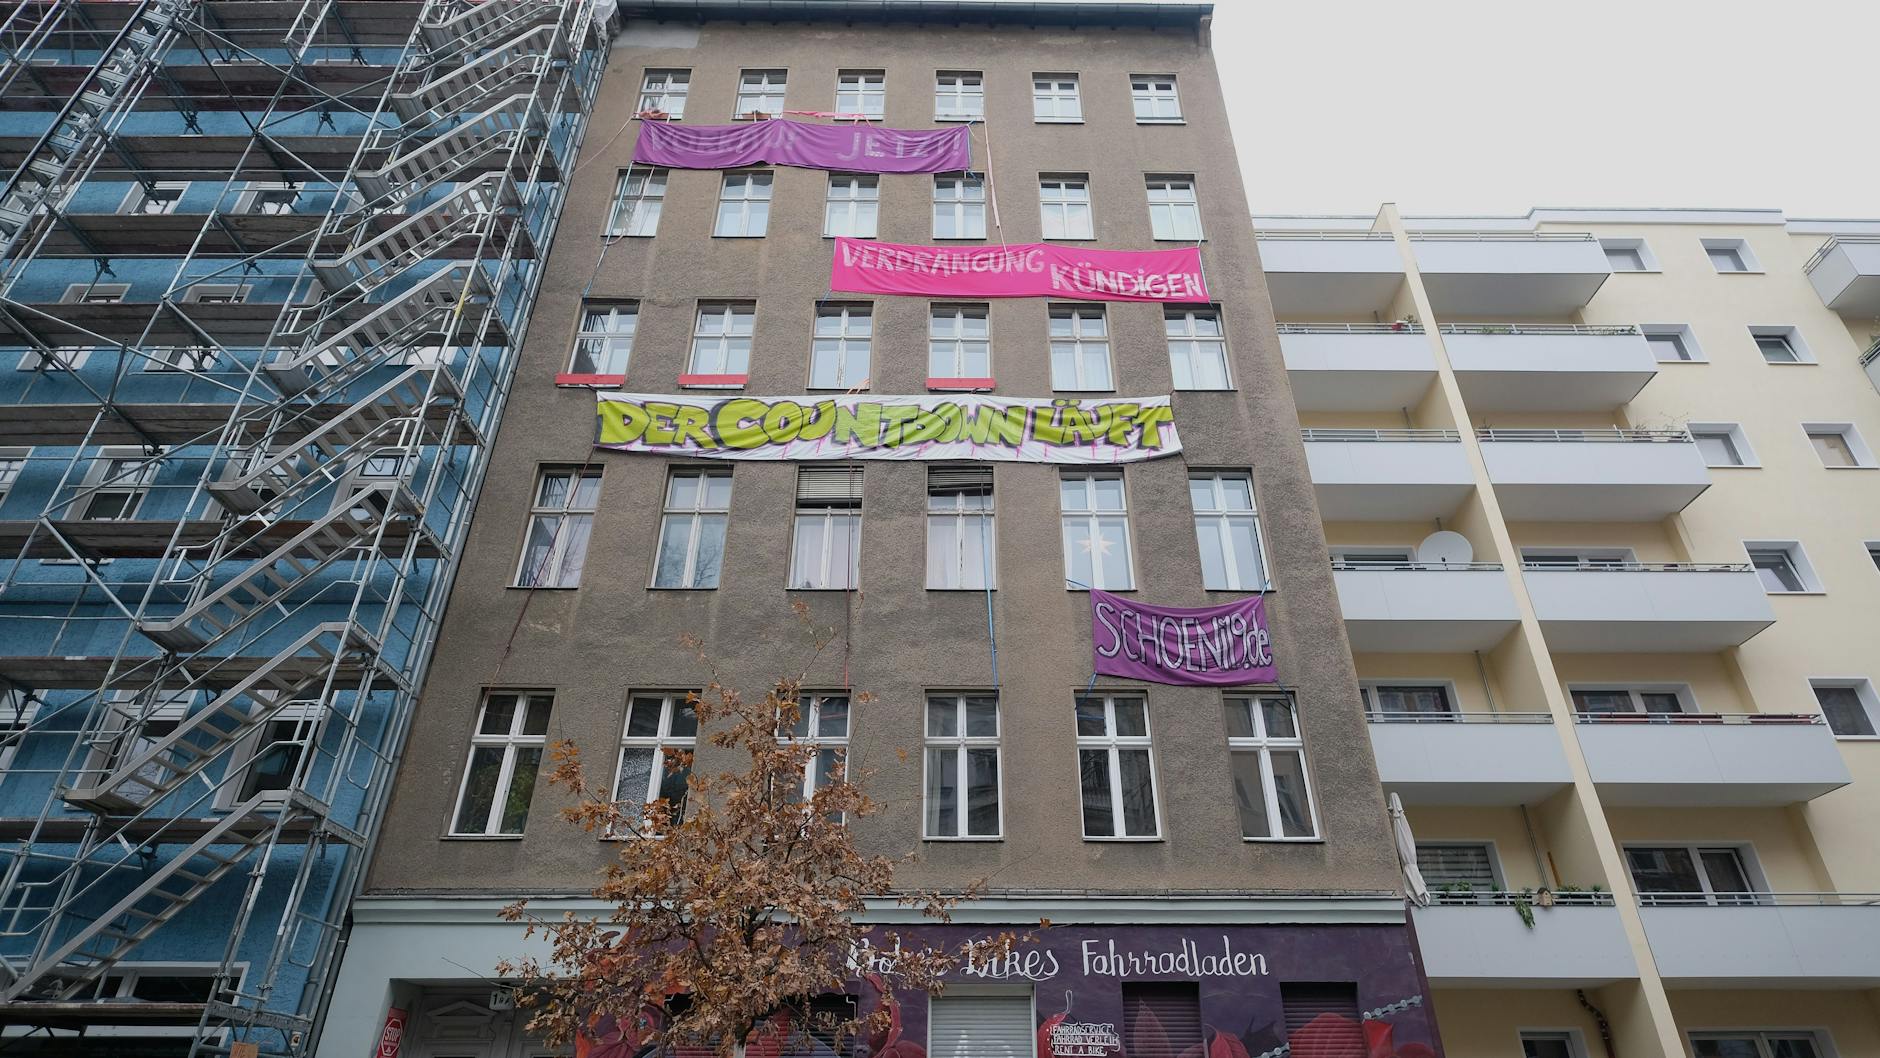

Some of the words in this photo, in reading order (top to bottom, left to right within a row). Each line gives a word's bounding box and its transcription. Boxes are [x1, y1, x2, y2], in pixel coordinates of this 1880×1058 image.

[841, 241, 1045, 278] VERDRÄNGUNG
[594, 399, 718, 450] DER
[711, 398, 1027, 451] COUNTDOWN
[1032, 398, 1174, 451] LÄUFT
[1081, 935, 1270, 977] Fahrradladen
[384, 1026, 401, 1043] STOP
[1052, 1025, 1112, 1035] FAHRRADSERVICE
[1053, 1034, 1083, 1044] FAHRRAD
[1086, 1035, 1118, 1046] VERLEIH
[1054, 1045, 1074, 1055] RENT
[1078, 1046, 1085, 1055] A
[1088, 1045, 1105, 1056] BIKE
